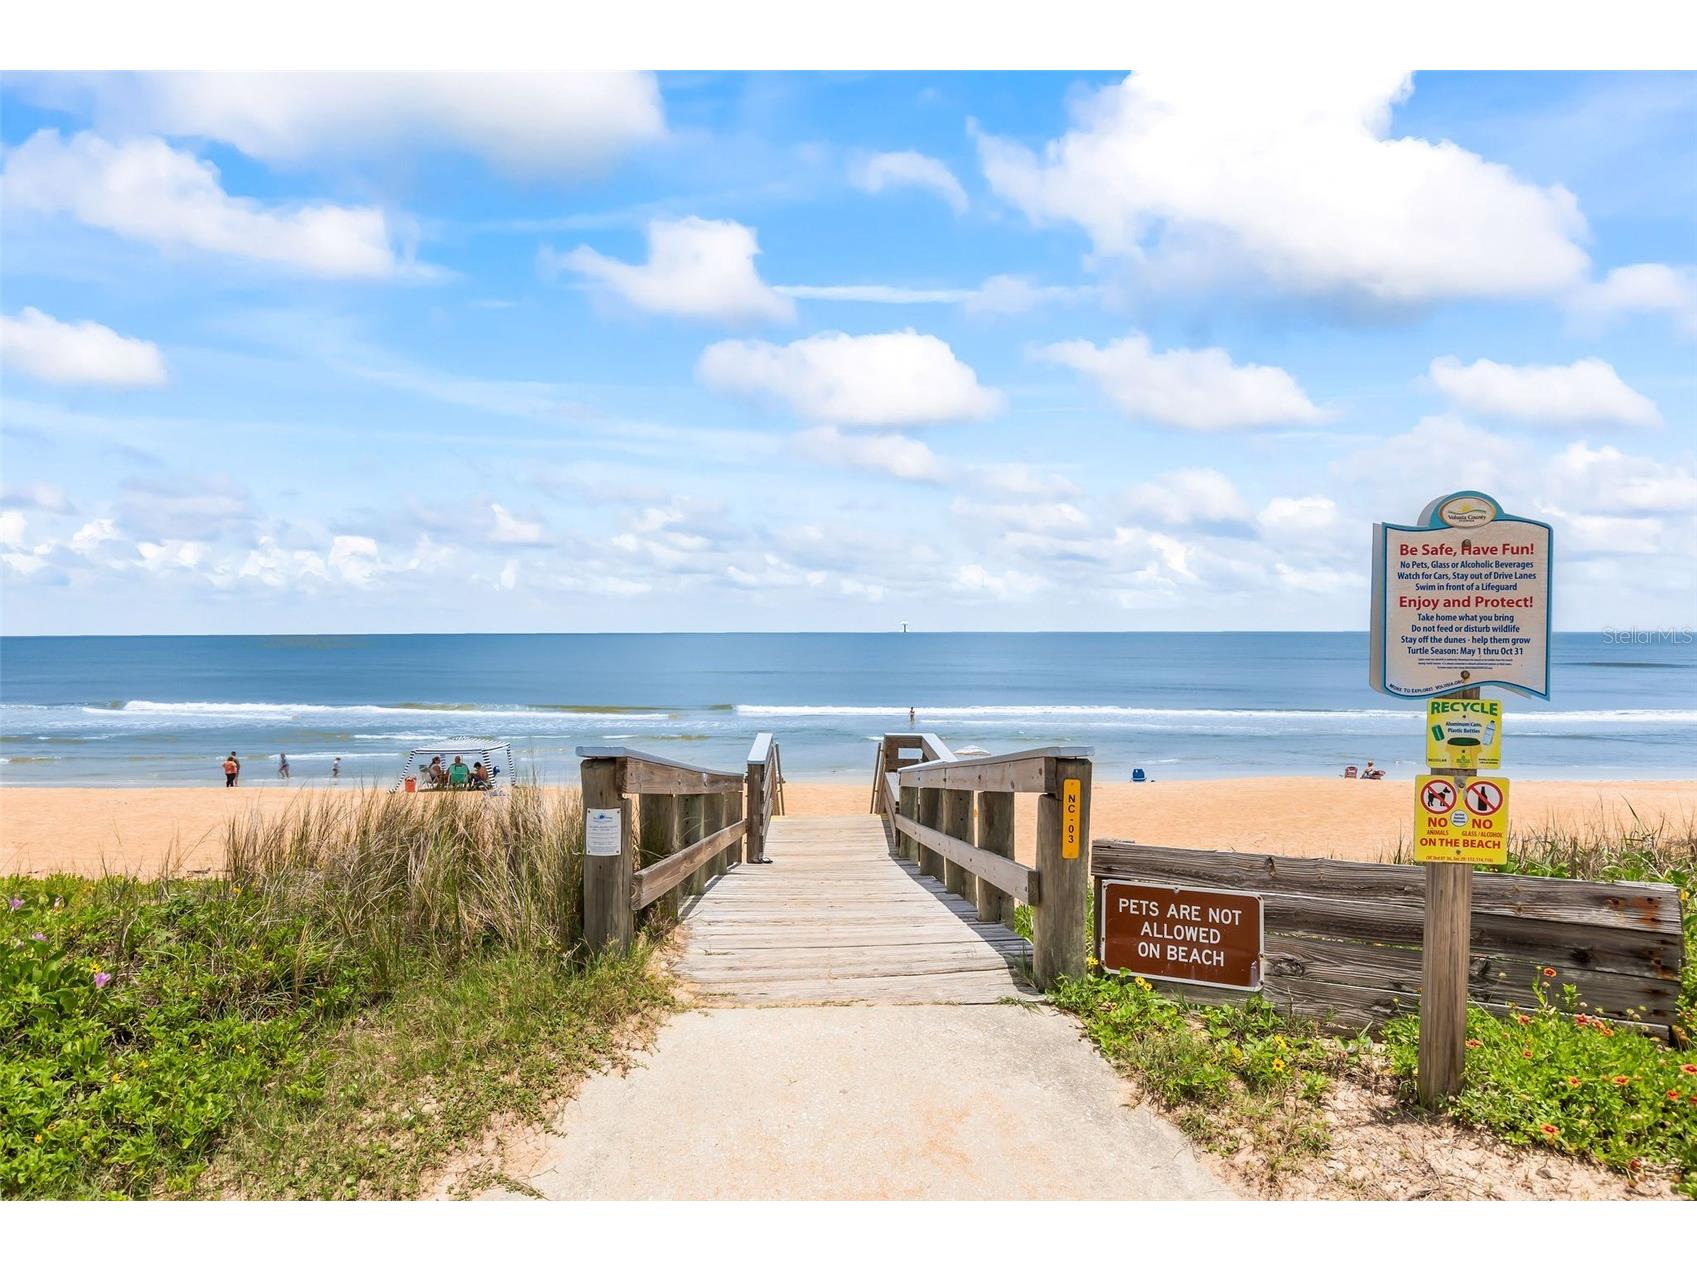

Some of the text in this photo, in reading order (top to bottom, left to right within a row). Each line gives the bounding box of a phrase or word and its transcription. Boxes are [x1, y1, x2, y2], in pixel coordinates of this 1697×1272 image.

[1400, 543, 1534, 557] Be Safe, Have Fun!
[1412, 561, 1429, 569] Pets,
[1431, 561, 1450, 569] Glass
[1460, 561, 1494, 569] Alcoholic
[1495, 561, 1534, 570] Beverages
[1397, 572, 1420, 580] Watch
[1421, 572, 1432, 580] for
[1433, 572, 1451, 581] Cars,
[1452, 572, 1469, 581] Stay
[1484, 572, 1492, 580] of
[1493, 572, 1513, 580] Drive
[1515, 572, 1536, 580] Lanes
[1415, 583, 1436, 591] Swim
[1437, 583, 1444, 591] in
[1446, 583, 1465, 591] front
[1481, 583, 1517, 592] Lifeguard
[1400, 595, 1533, 610] Enjoy and Protect!
[1417, 613, 1514, 623] Take home what you bring
[1411, 624, 1421, 632] Do
[1437, 624, 1453, 632] feed
[1464, 624, 1490, 632] disturb
[1492, 624, 1520, 632] wildlife
[1401, 635, 1417, 645] Stay
[1418, 635, 1429, 643] off
[1430, 635, 1442, 643] the
[1472, 636, 1488, 645] help
[1490, 636, 1510, 644] them
[1407, 646, 1429, 654] Turtle
[1430, 646, 1459, 654] Season:
[1460, 647, 1475, 656] May
[1483, 647, 1499, 655] thru
[1500, 647, 1513, 655] Oct
[1431, 701, 1498, 717] RECYCLE
[1428, 817, 1448, 827] NO
[1471, 818, 1493, 829] NO
[1420, 837, 1501, 849] ON THE BEACH
[1119, 898, 1242, 926] PETS ARE NOT
[1140, 921, 1221, 944] ALLOWED
[1138, 941, 1224, 967] ON BEACH
